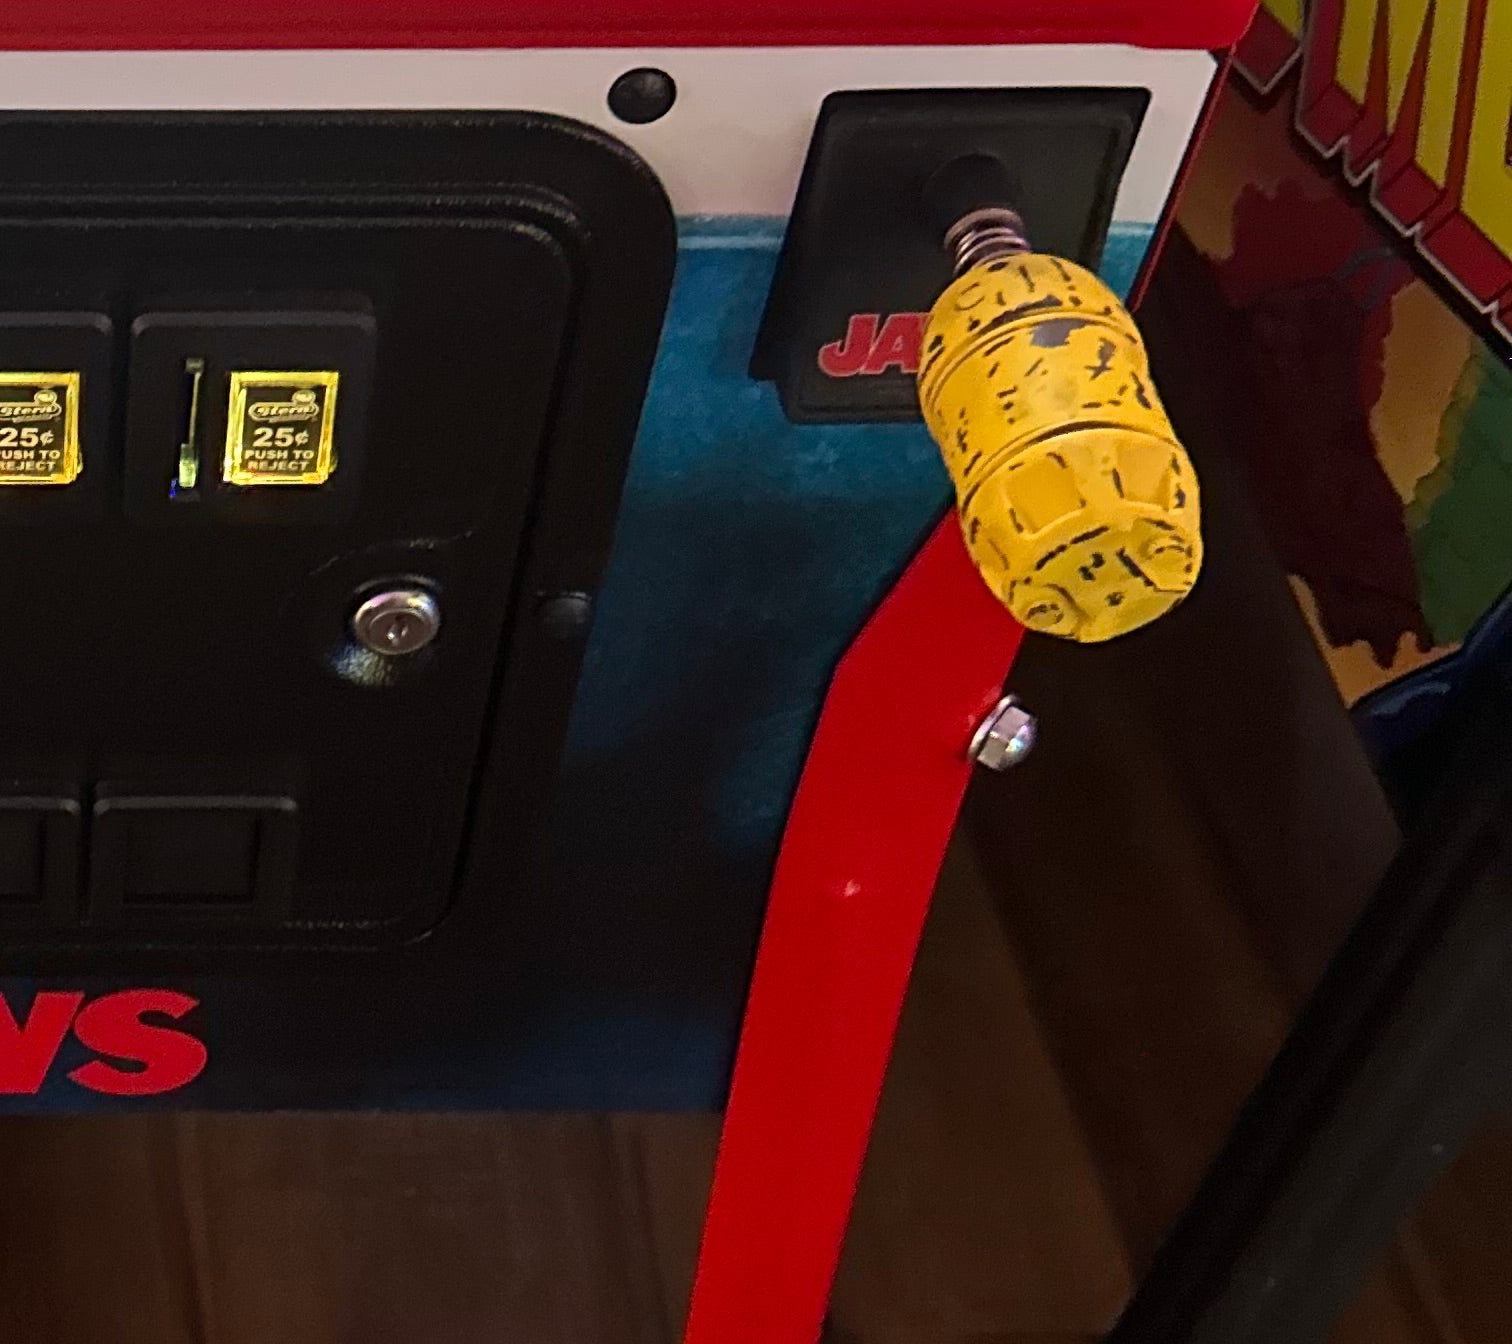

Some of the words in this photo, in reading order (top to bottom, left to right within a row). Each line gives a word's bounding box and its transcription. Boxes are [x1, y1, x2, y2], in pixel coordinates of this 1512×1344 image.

[817, 313, 929, 378] JA
[252, 427, 310, 448] 25¢
[39, 449, 61, 460] TO
[244, 449, 288, 460] PUSH
[292, 449, 315, 460] TO
[248, 461, 309, 472] REJECT
